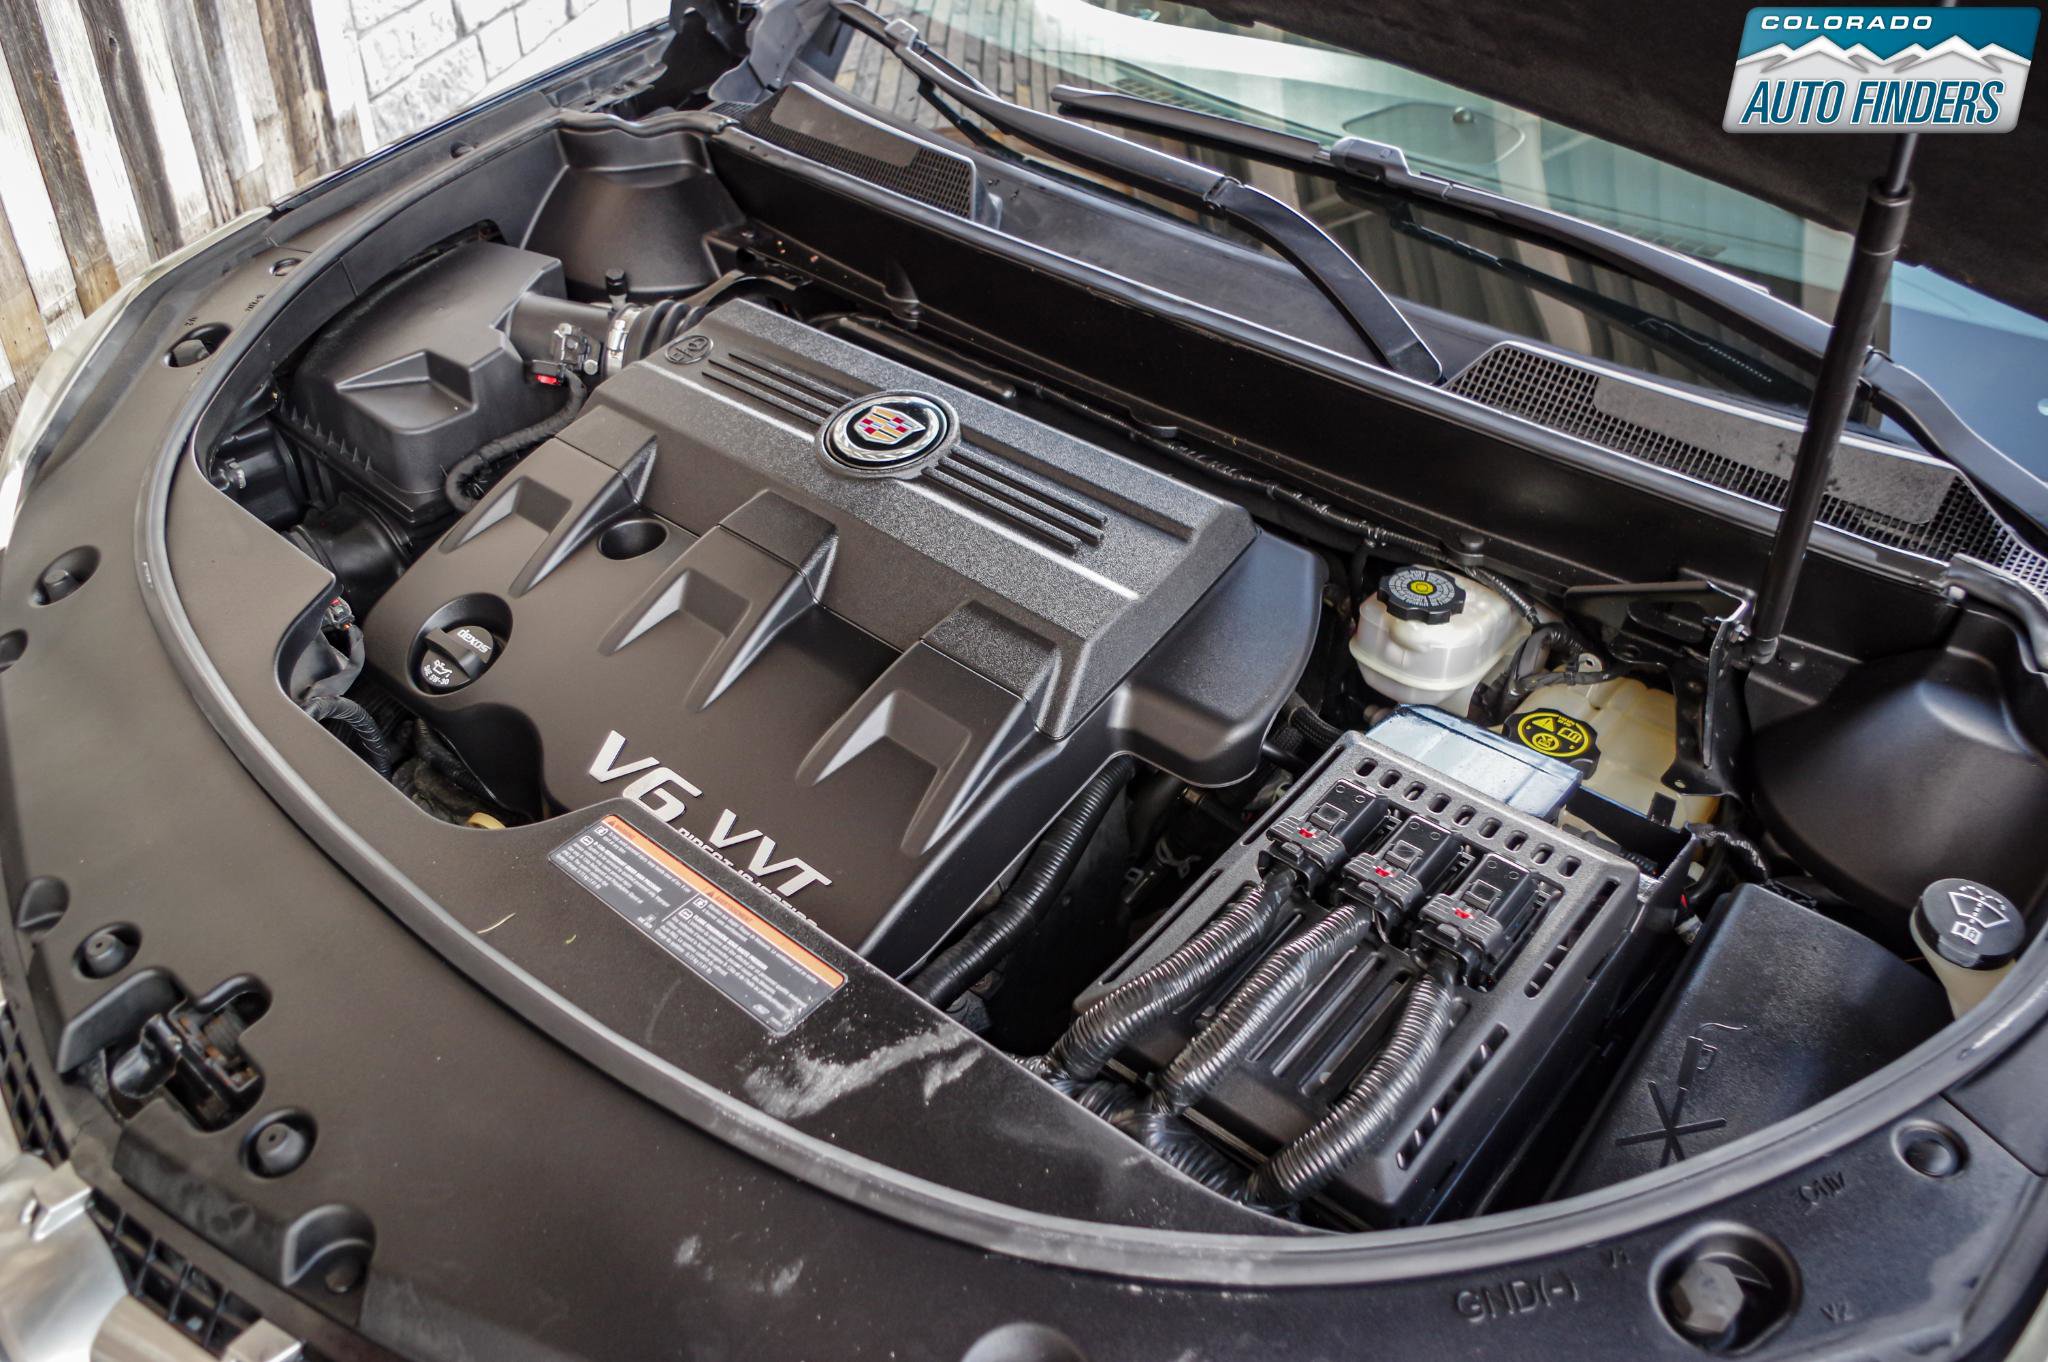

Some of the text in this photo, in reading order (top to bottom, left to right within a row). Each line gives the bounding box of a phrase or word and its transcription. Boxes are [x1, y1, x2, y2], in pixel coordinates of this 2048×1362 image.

[456, 628, 493, 654] dexos
[589, 729, 703, 823] V6
[708, 808, 833, 898] VVT
[1456, 1271, 1580, 1325] GND(-)
